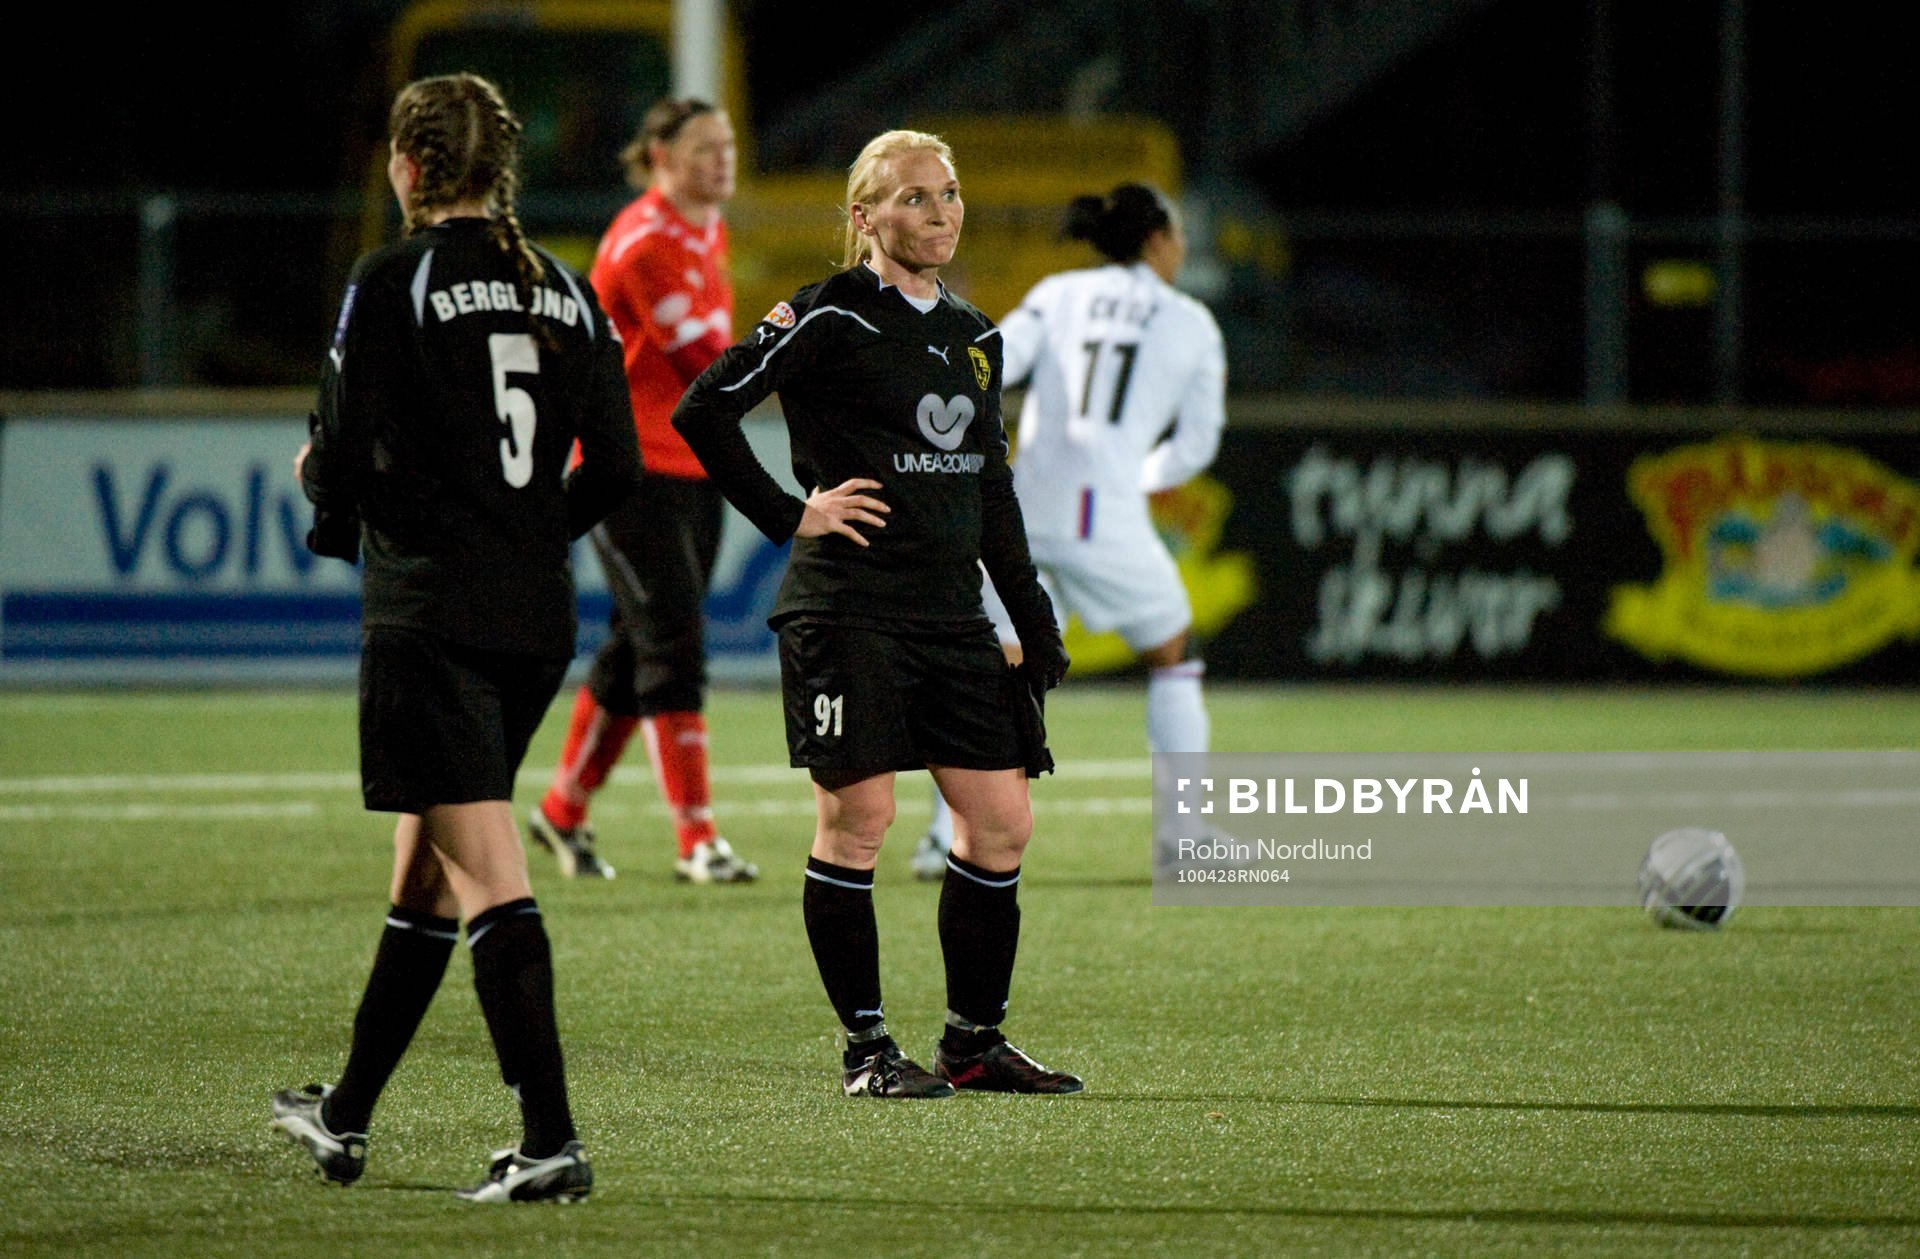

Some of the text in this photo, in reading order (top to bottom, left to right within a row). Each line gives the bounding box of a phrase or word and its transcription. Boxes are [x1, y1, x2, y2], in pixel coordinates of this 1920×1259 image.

[488, 333, 540, 488] 5
[1080, 339, 1141, 425] 11
[814, 693, 844, 736] 91
